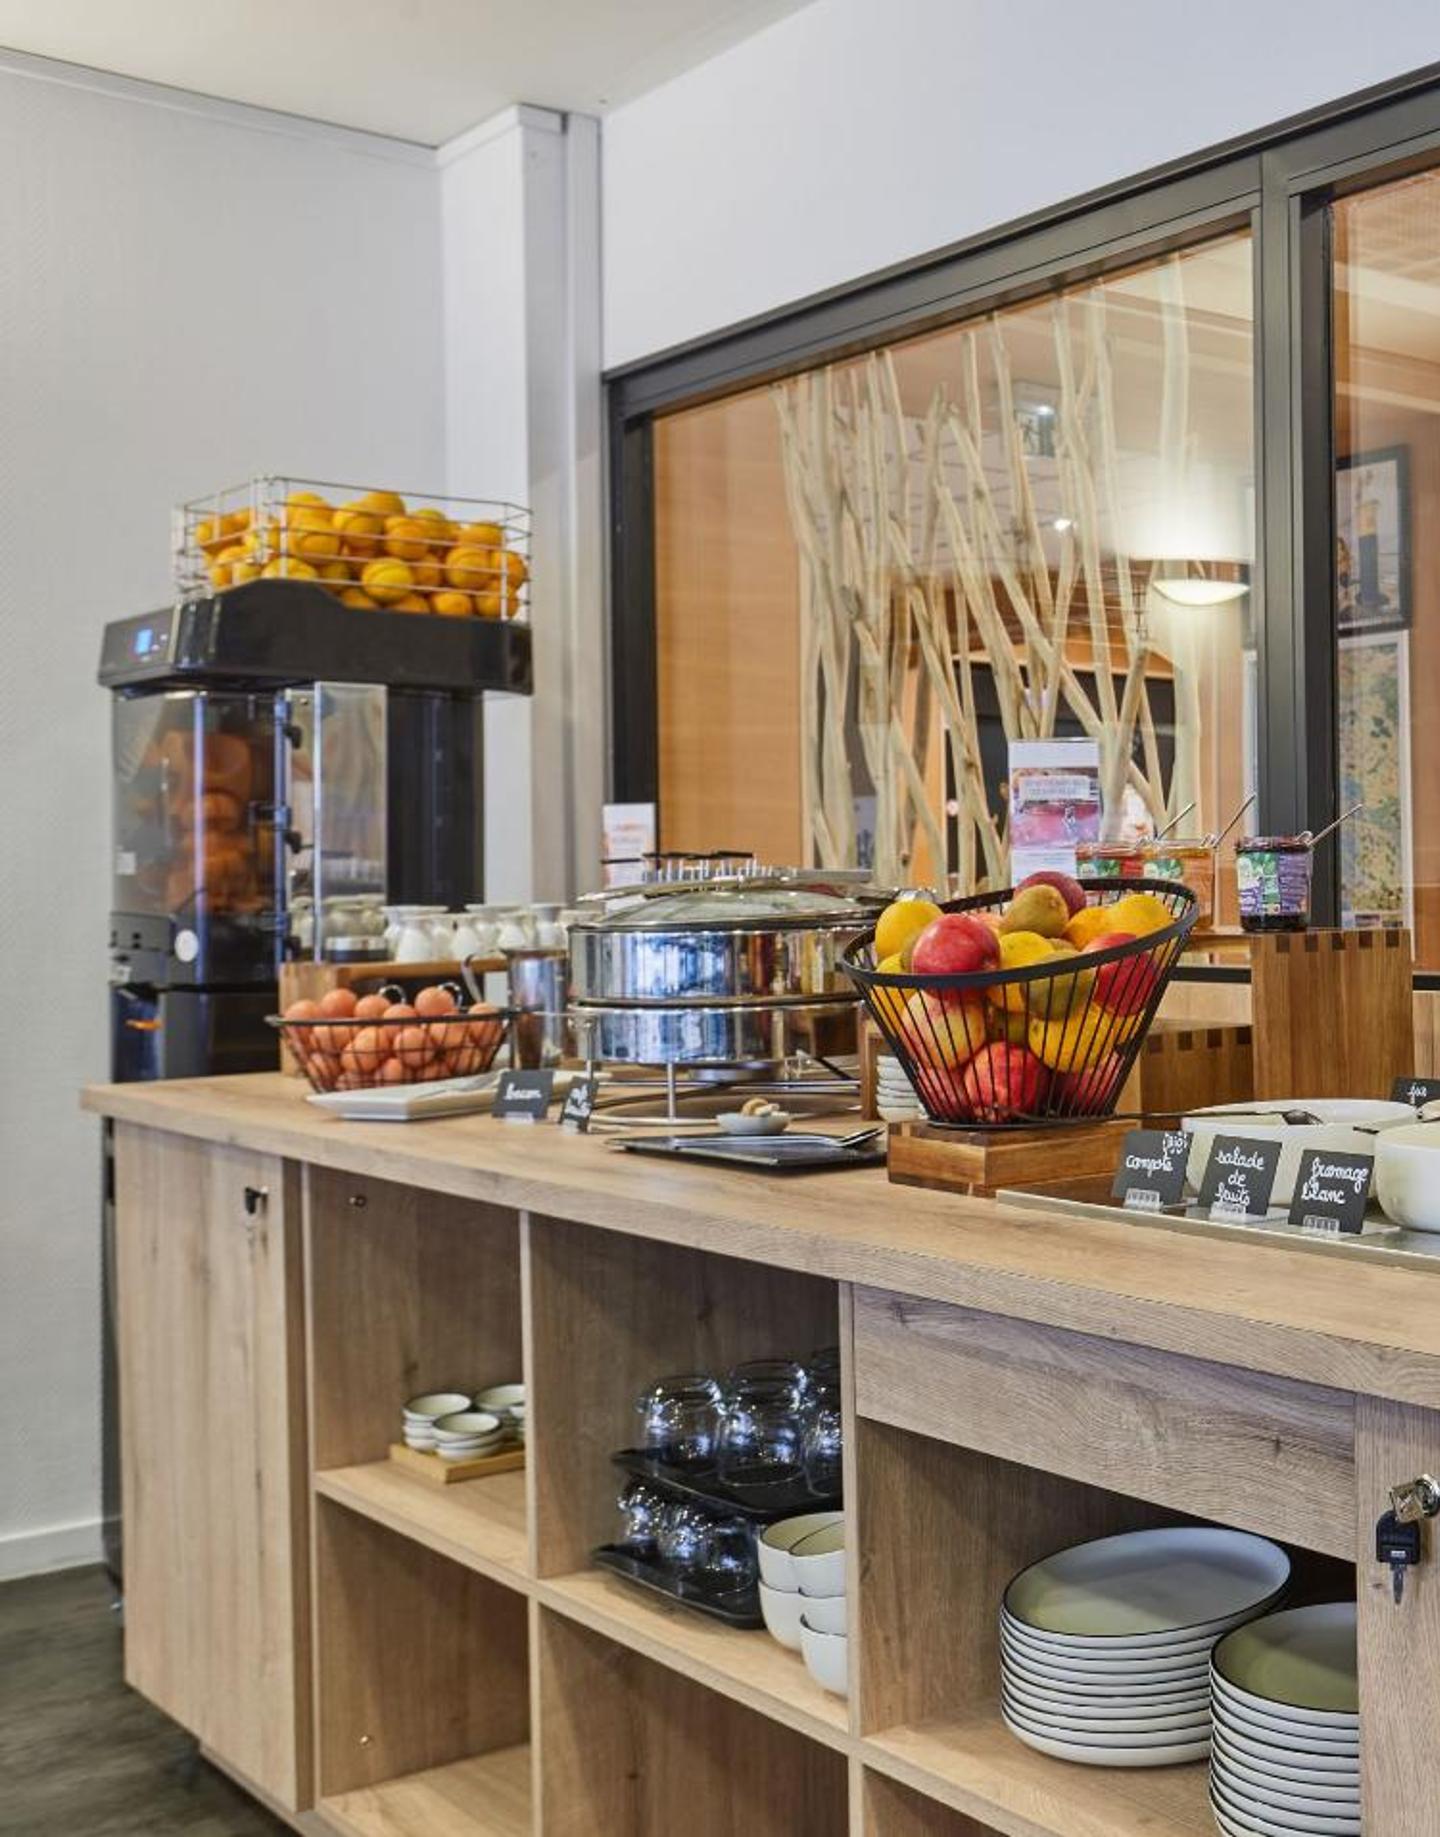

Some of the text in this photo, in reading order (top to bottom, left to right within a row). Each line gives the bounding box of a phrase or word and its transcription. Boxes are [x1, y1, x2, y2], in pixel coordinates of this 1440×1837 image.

[1126, 1150, 1173, 1178] compote
[1215, 1146, 1265, 1170] salade
[1228, 1169, 1247, 1187] de
[1312, 1157, 1369, 1194] fromage
[1301, 1180, 1345, 1204] blanc
